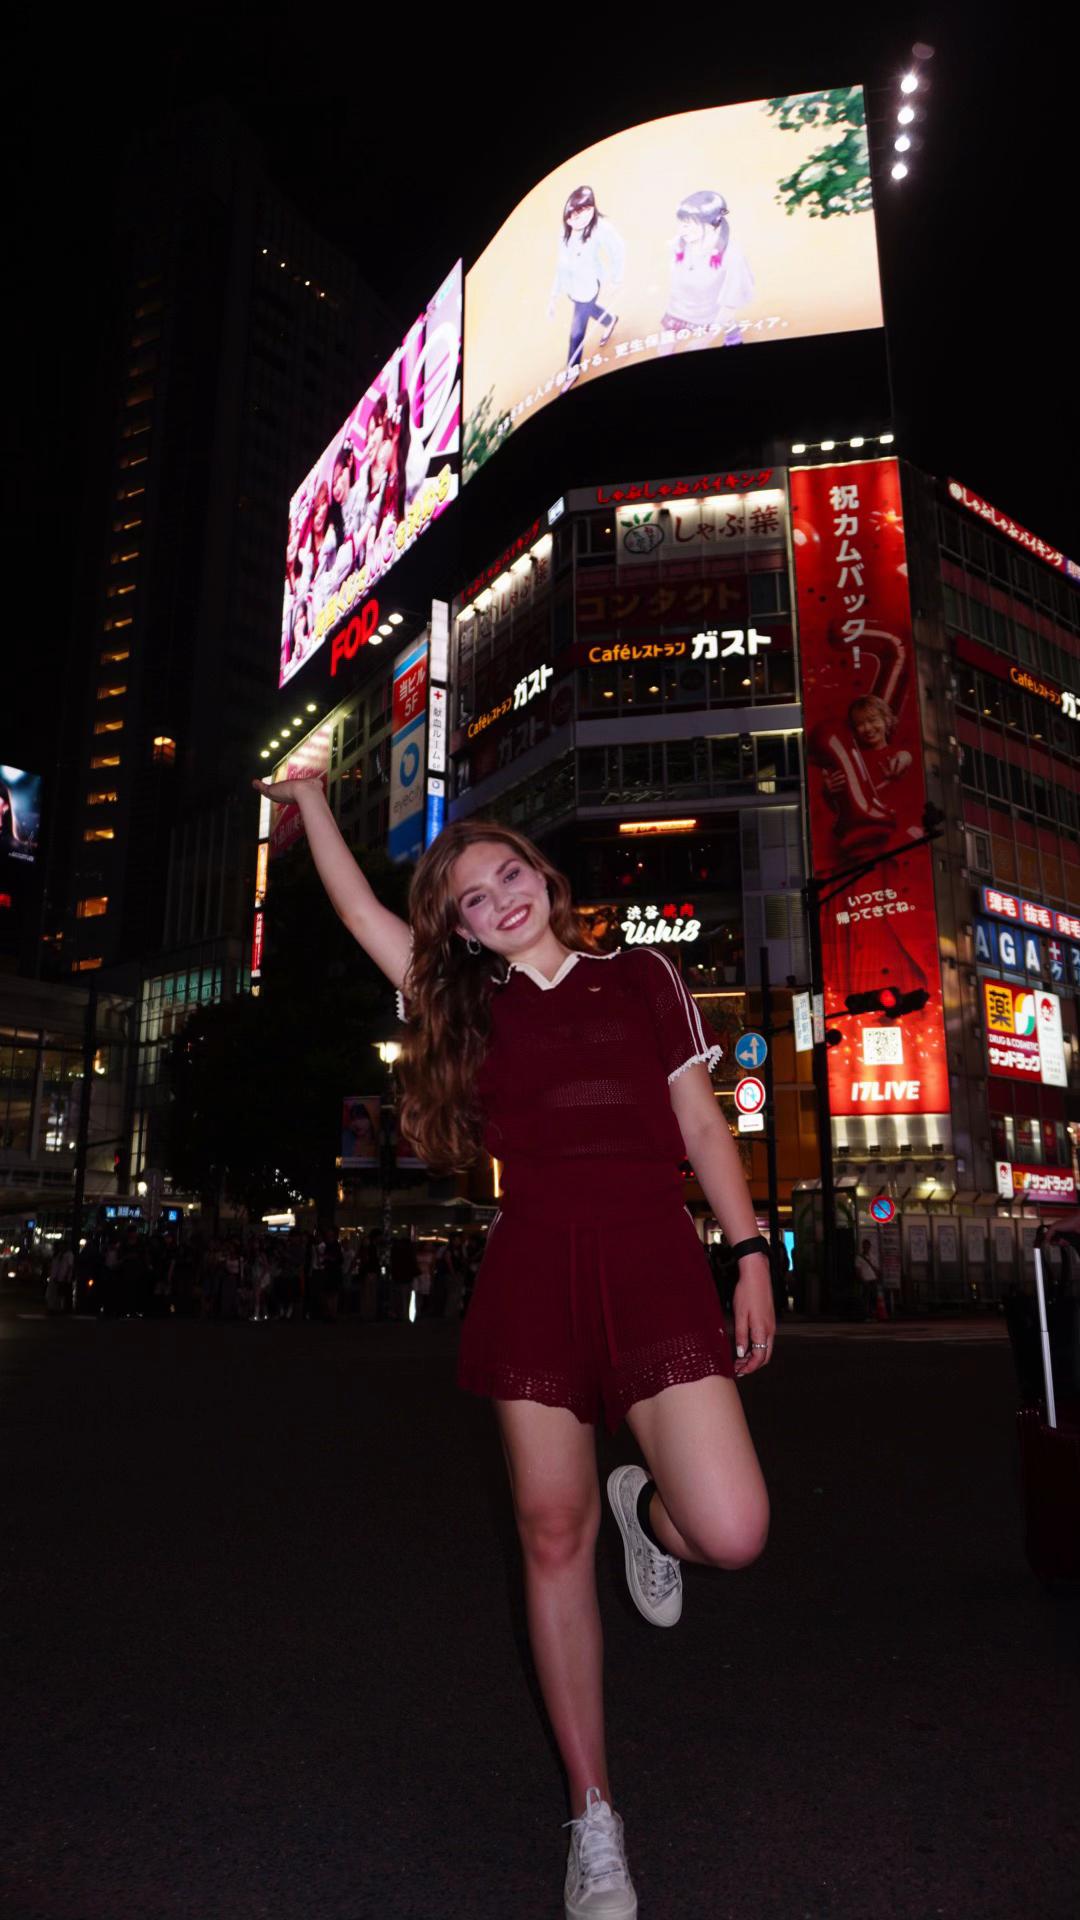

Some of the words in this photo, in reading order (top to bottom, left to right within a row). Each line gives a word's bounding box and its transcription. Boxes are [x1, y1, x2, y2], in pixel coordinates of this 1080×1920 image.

[675, 505, 780, 543] しゃぶ葉
[330, 599, 379, 677] FOD
[690, 629, 772, 660] ガスト
[513, 664, 554, 710] ガスト
[836, 901, 916, 925] 帰ってきてね。
[848, 888, 897, 907] いつでも
[976, 925, 1041, 972] AGA
[852, 1081, 920, 1101] 17LIVE
